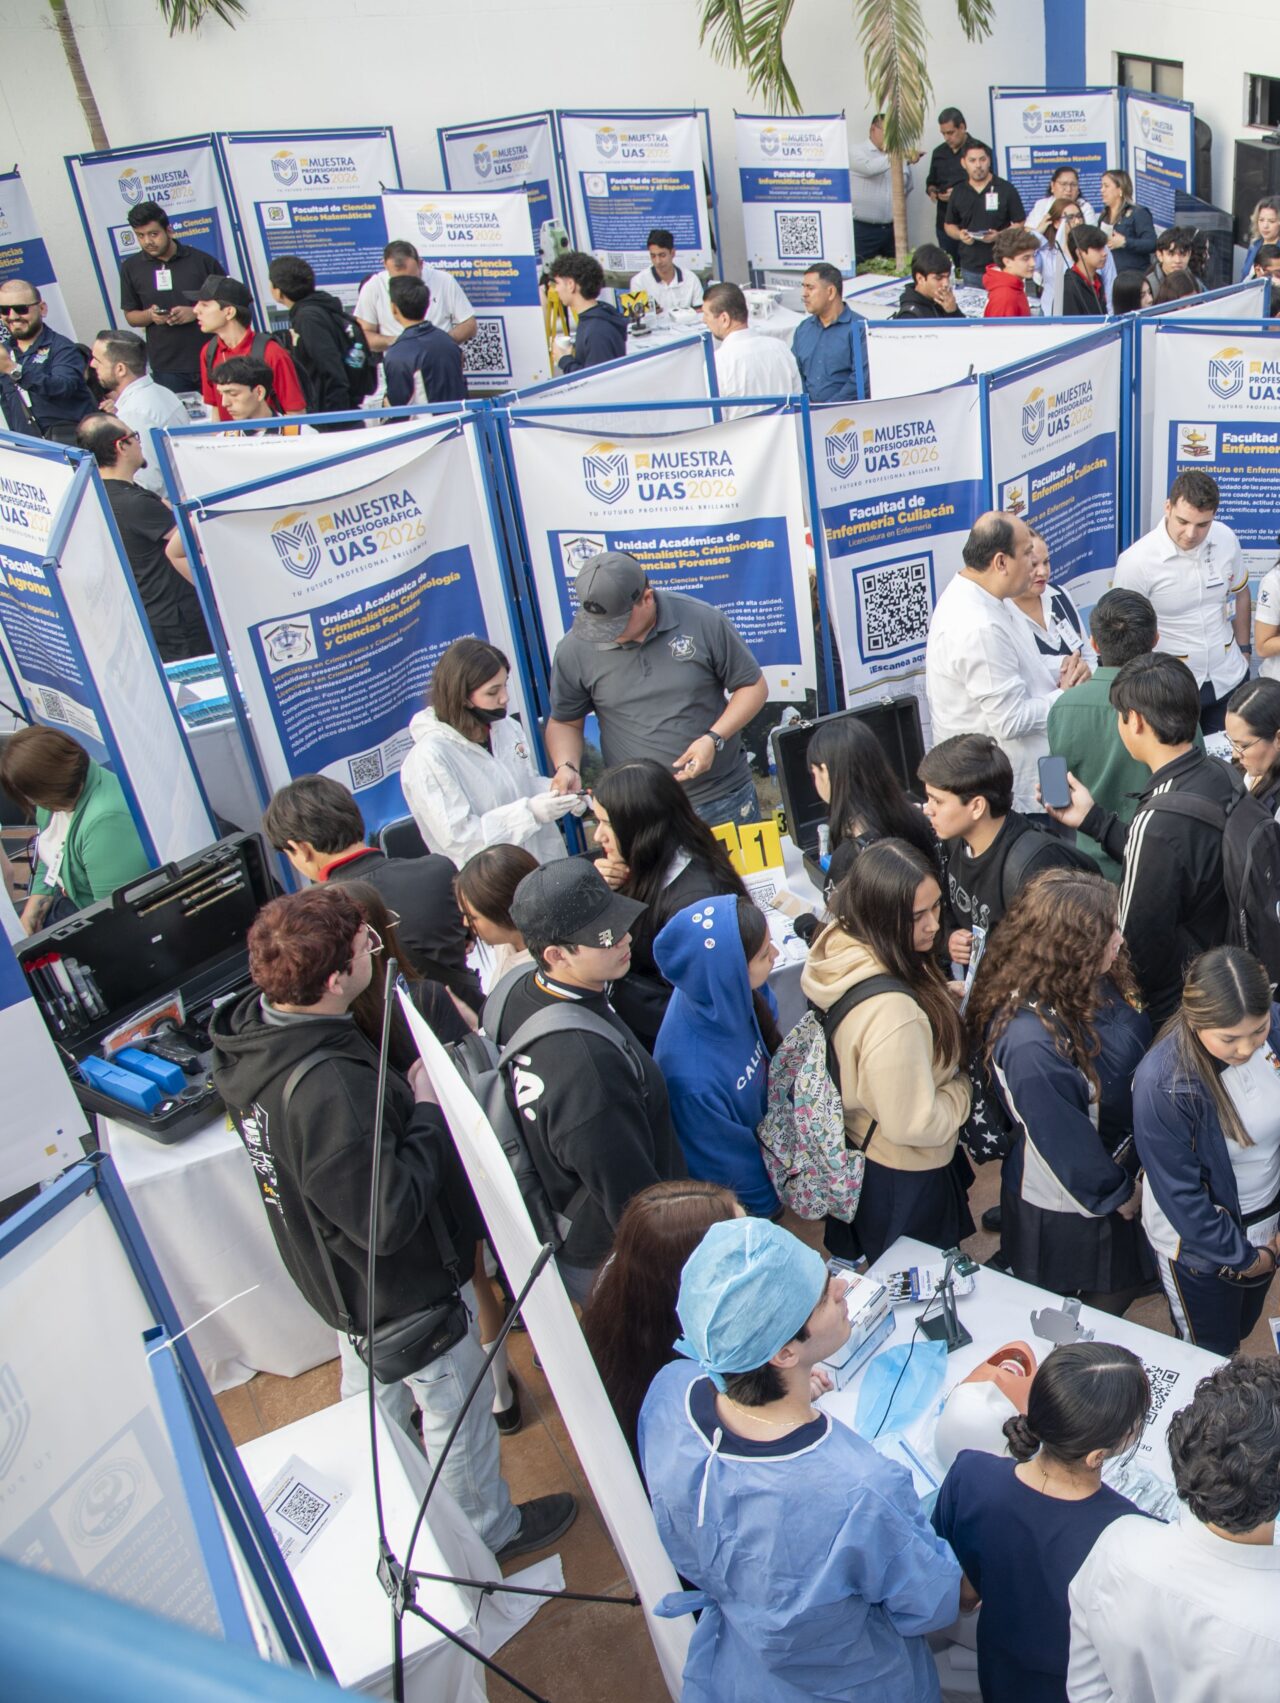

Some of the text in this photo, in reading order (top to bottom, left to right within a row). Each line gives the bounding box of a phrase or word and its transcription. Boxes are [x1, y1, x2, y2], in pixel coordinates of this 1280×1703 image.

[1050, 110, 1086, 118] MUESTRA
[627, 133, 668, 142] MUESTRA
[1044, 124, 1065, 133] UAS
[308, 157, 355, 167] MUESTRA
[622, 148, 645, 158] UAS
[782, 147, 802, 156] UAS
[150, 169, 188, 183] MUESTRA
[303, 174, 330, 185] UAS
[494, 163, 512, 176] UAS
[292, 205, 329, 214] Facultad
[453, 213, 498, 222] MUESTRA
[448, 230, 473, 241] UAS
[473, 259, 512, 268] Ciencias
[483, 269, 519, 278] Espacio
[1055, 380, 1093, 408] MUESTRA
[874, 419, 936, 442] MUESTRA
[1047, 406, 1093, 437] UAS 2026
[863, 435, 938, 455] PROFESIOGRÁFICA
[1222, 432, 1277, 444] Facultad
[651, 450, 732, 469] MUESTRA
[864, 445, 939, 473] UAS 2026
[636, 468, 735, 481] PROFESIOGRÁFICA
[1031, 461, 1076, 491] Facultad de
[0, 477, 48, 504] MUESTRA
[638, 480, 737, 501] UAS 2026
[1031, 475, 1073, 503] Enfermería
[0, 504, 29, 527] UAS
[333, 489, 416, 530] MUESTRA
[849, 495, 926, 521] Facultad de
[324, 507, 422, 546] PROFESIOGRÁFICA
[825, 502, 955, 541] Enfermería Culiacán
[329, 518, 426, 566] UAS 2026
[614, 533, 740, 550] Unidad Académica de
[848, 532, 885, 547] Licenciatura
[896, 523, 932, 536] Enfermería
[702, 538, 775, 556] Criminología
[0, 555, 46, 578] Faculta
[678, 556, 731, 569] Forenses
[8, 573, 52, 598] Agrono
[320, 572, 427, 626] Unidad Académica de
[322, 571, 461, 637] Criminalística, Criminología
[335, 620, 381, 645] Ciencias
[382, 598, 421, 626] Forenses
[778, 812, 787, 833] 3
[754, 829, 768, 867] 1
